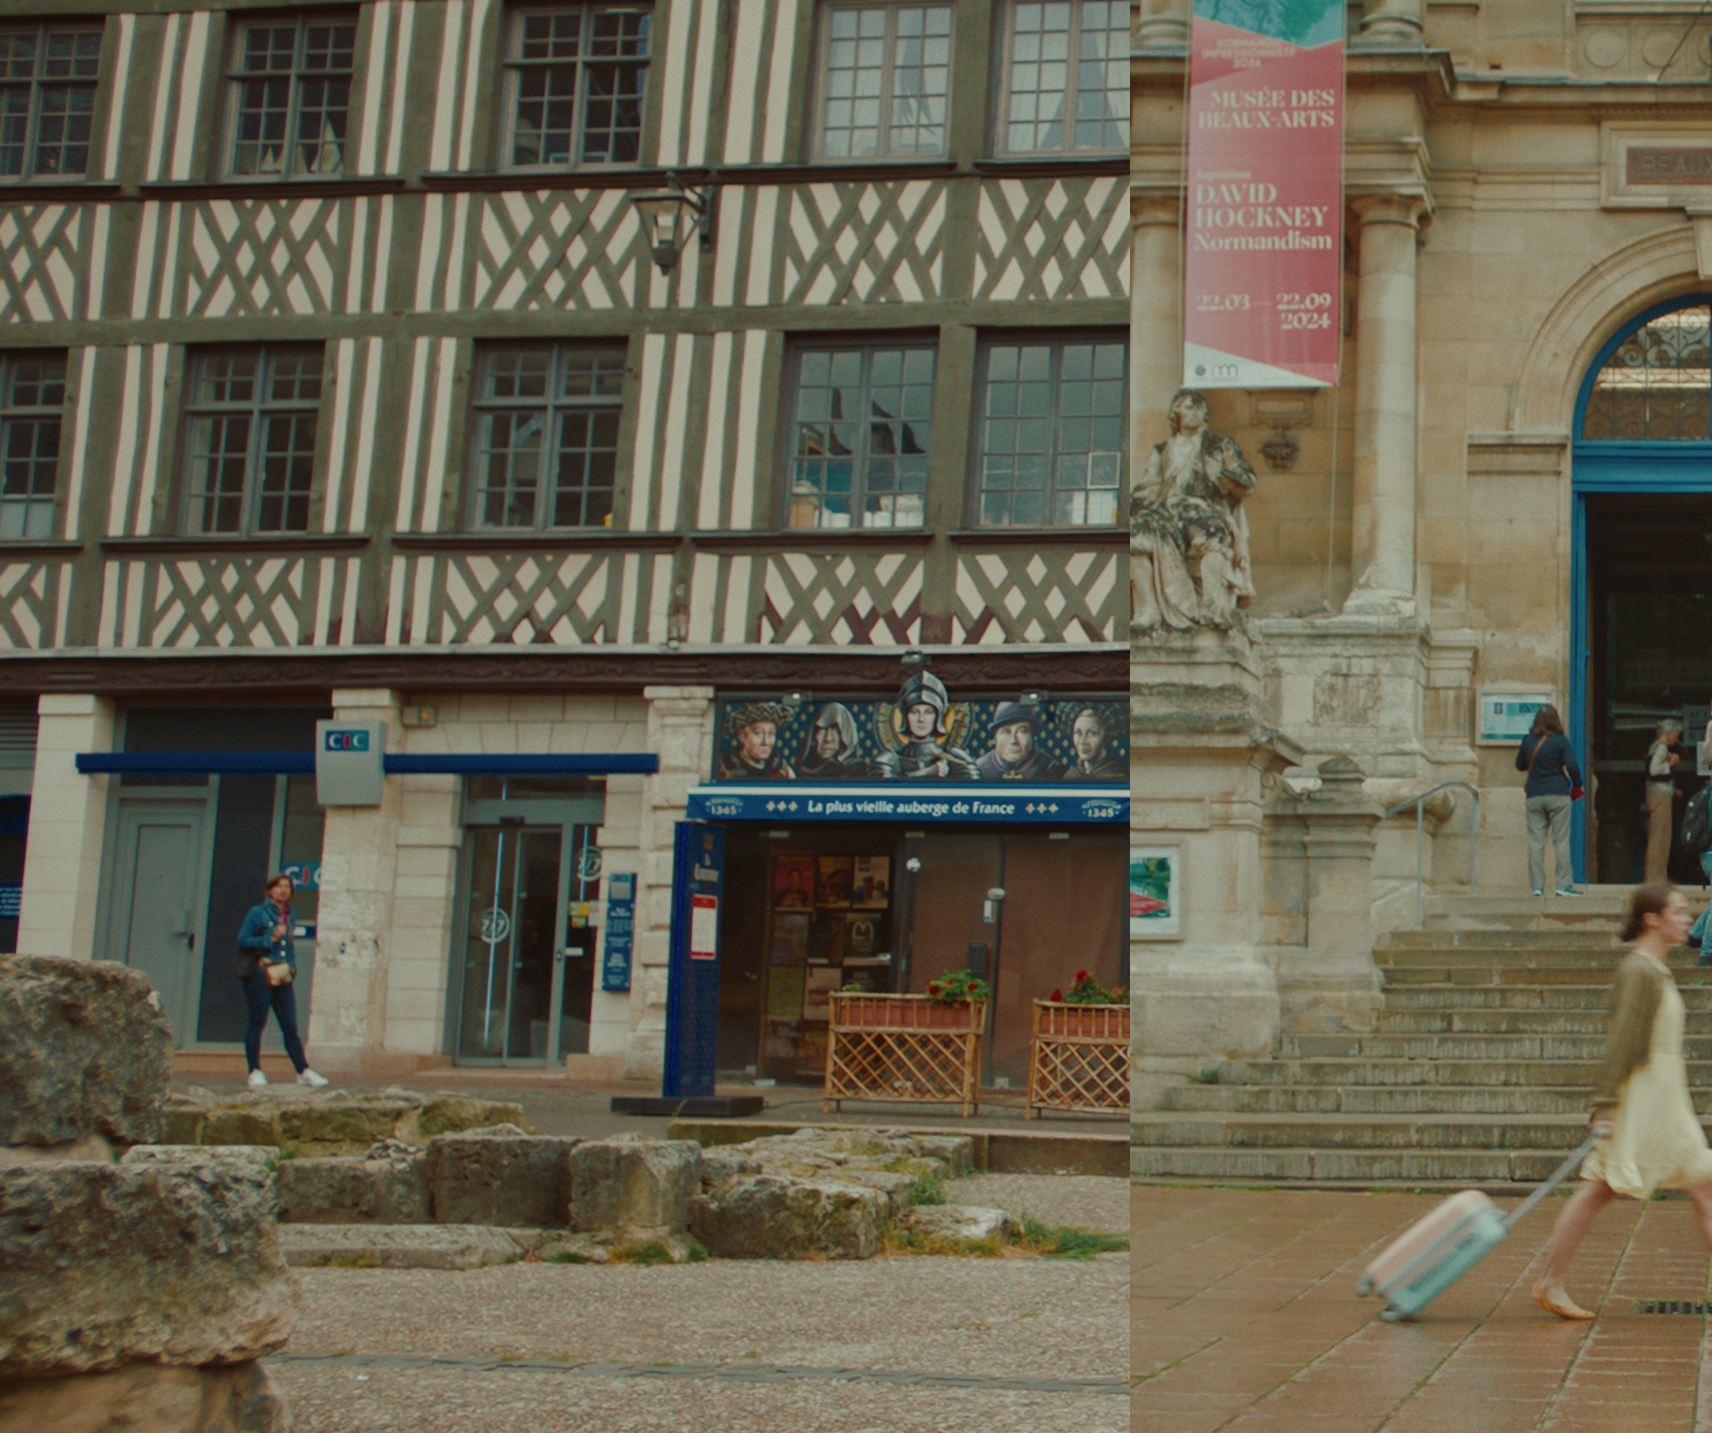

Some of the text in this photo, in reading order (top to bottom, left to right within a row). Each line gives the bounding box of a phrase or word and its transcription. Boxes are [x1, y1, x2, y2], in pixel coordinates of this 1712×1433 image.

[1210, 86, 1335, 109] MUSÉE DES
[1198, 110, 1335, 129] BEAUX-ARTS
[1196, 183, 1277, 204] DAVID
[1196, 206, 1328, 228] HOCKNEY
[1195, 229, 1332, 250] Normandism
[1196, 293, 1250, 311] 22.03
[1276, 292, 1332, 310] 22.09
[1281, 312, 1331, 330] 2024
[328, 732, 366, 749] CIC
[711, 805, 737, 815] 1345
[807, 799, 1015, 817] La plus vieille auberge de France
[1088, 807, 1114, 818] 1345
